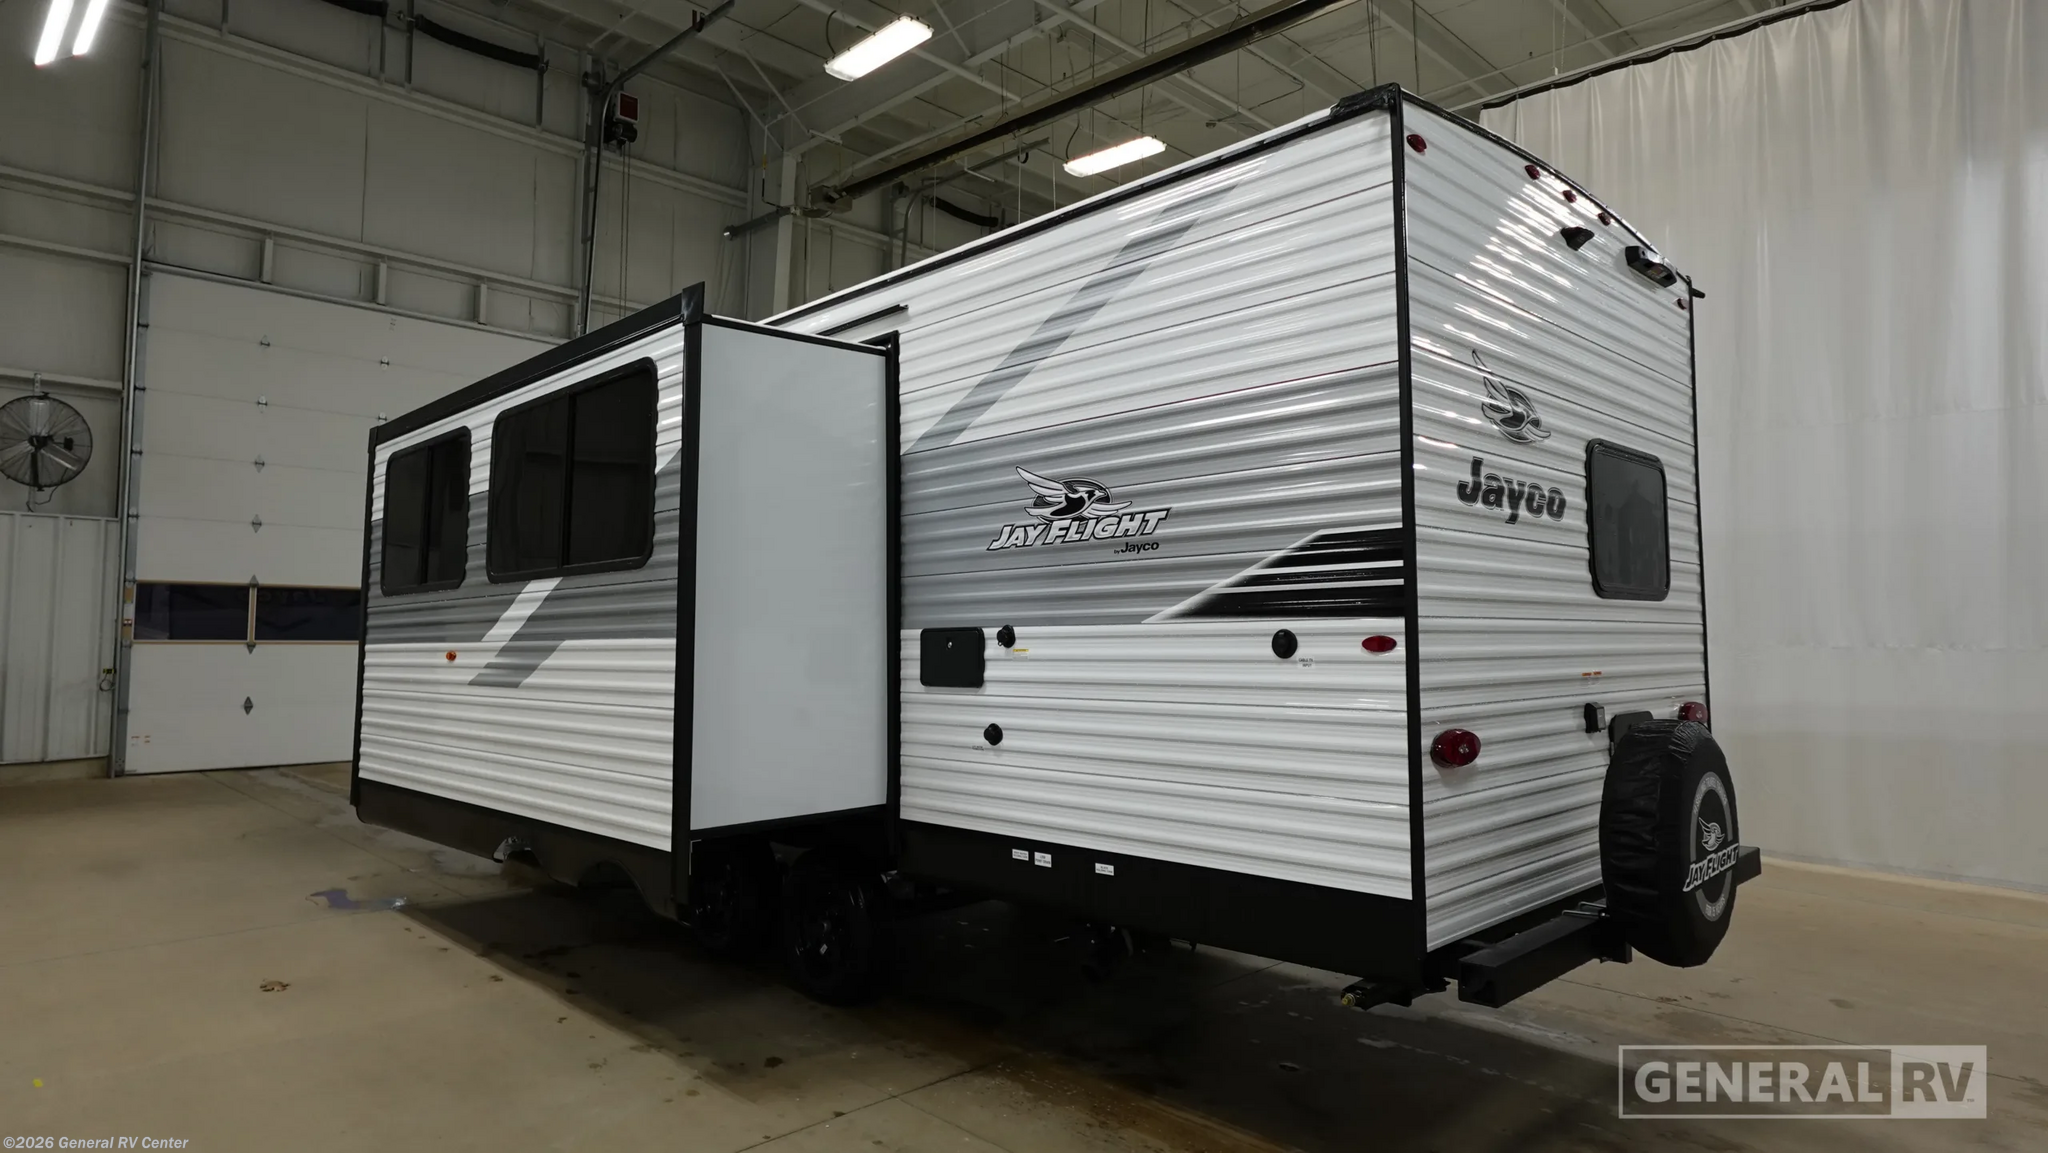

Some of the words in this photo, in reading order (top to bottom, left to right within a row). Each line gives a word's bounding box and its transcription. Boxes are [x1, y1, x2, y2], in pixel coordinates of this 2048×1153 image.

[1457, 456, 1567, 524] Jayco
[986, 523, 1046, 551] JAY
[1042, 507, 1172, 545] FLIGHT
[1120, 541, 1160, 555] Jayco
[1683, 859, 1707, 892] JAY
[1704, 843, 1739, 881] FLIGHT
